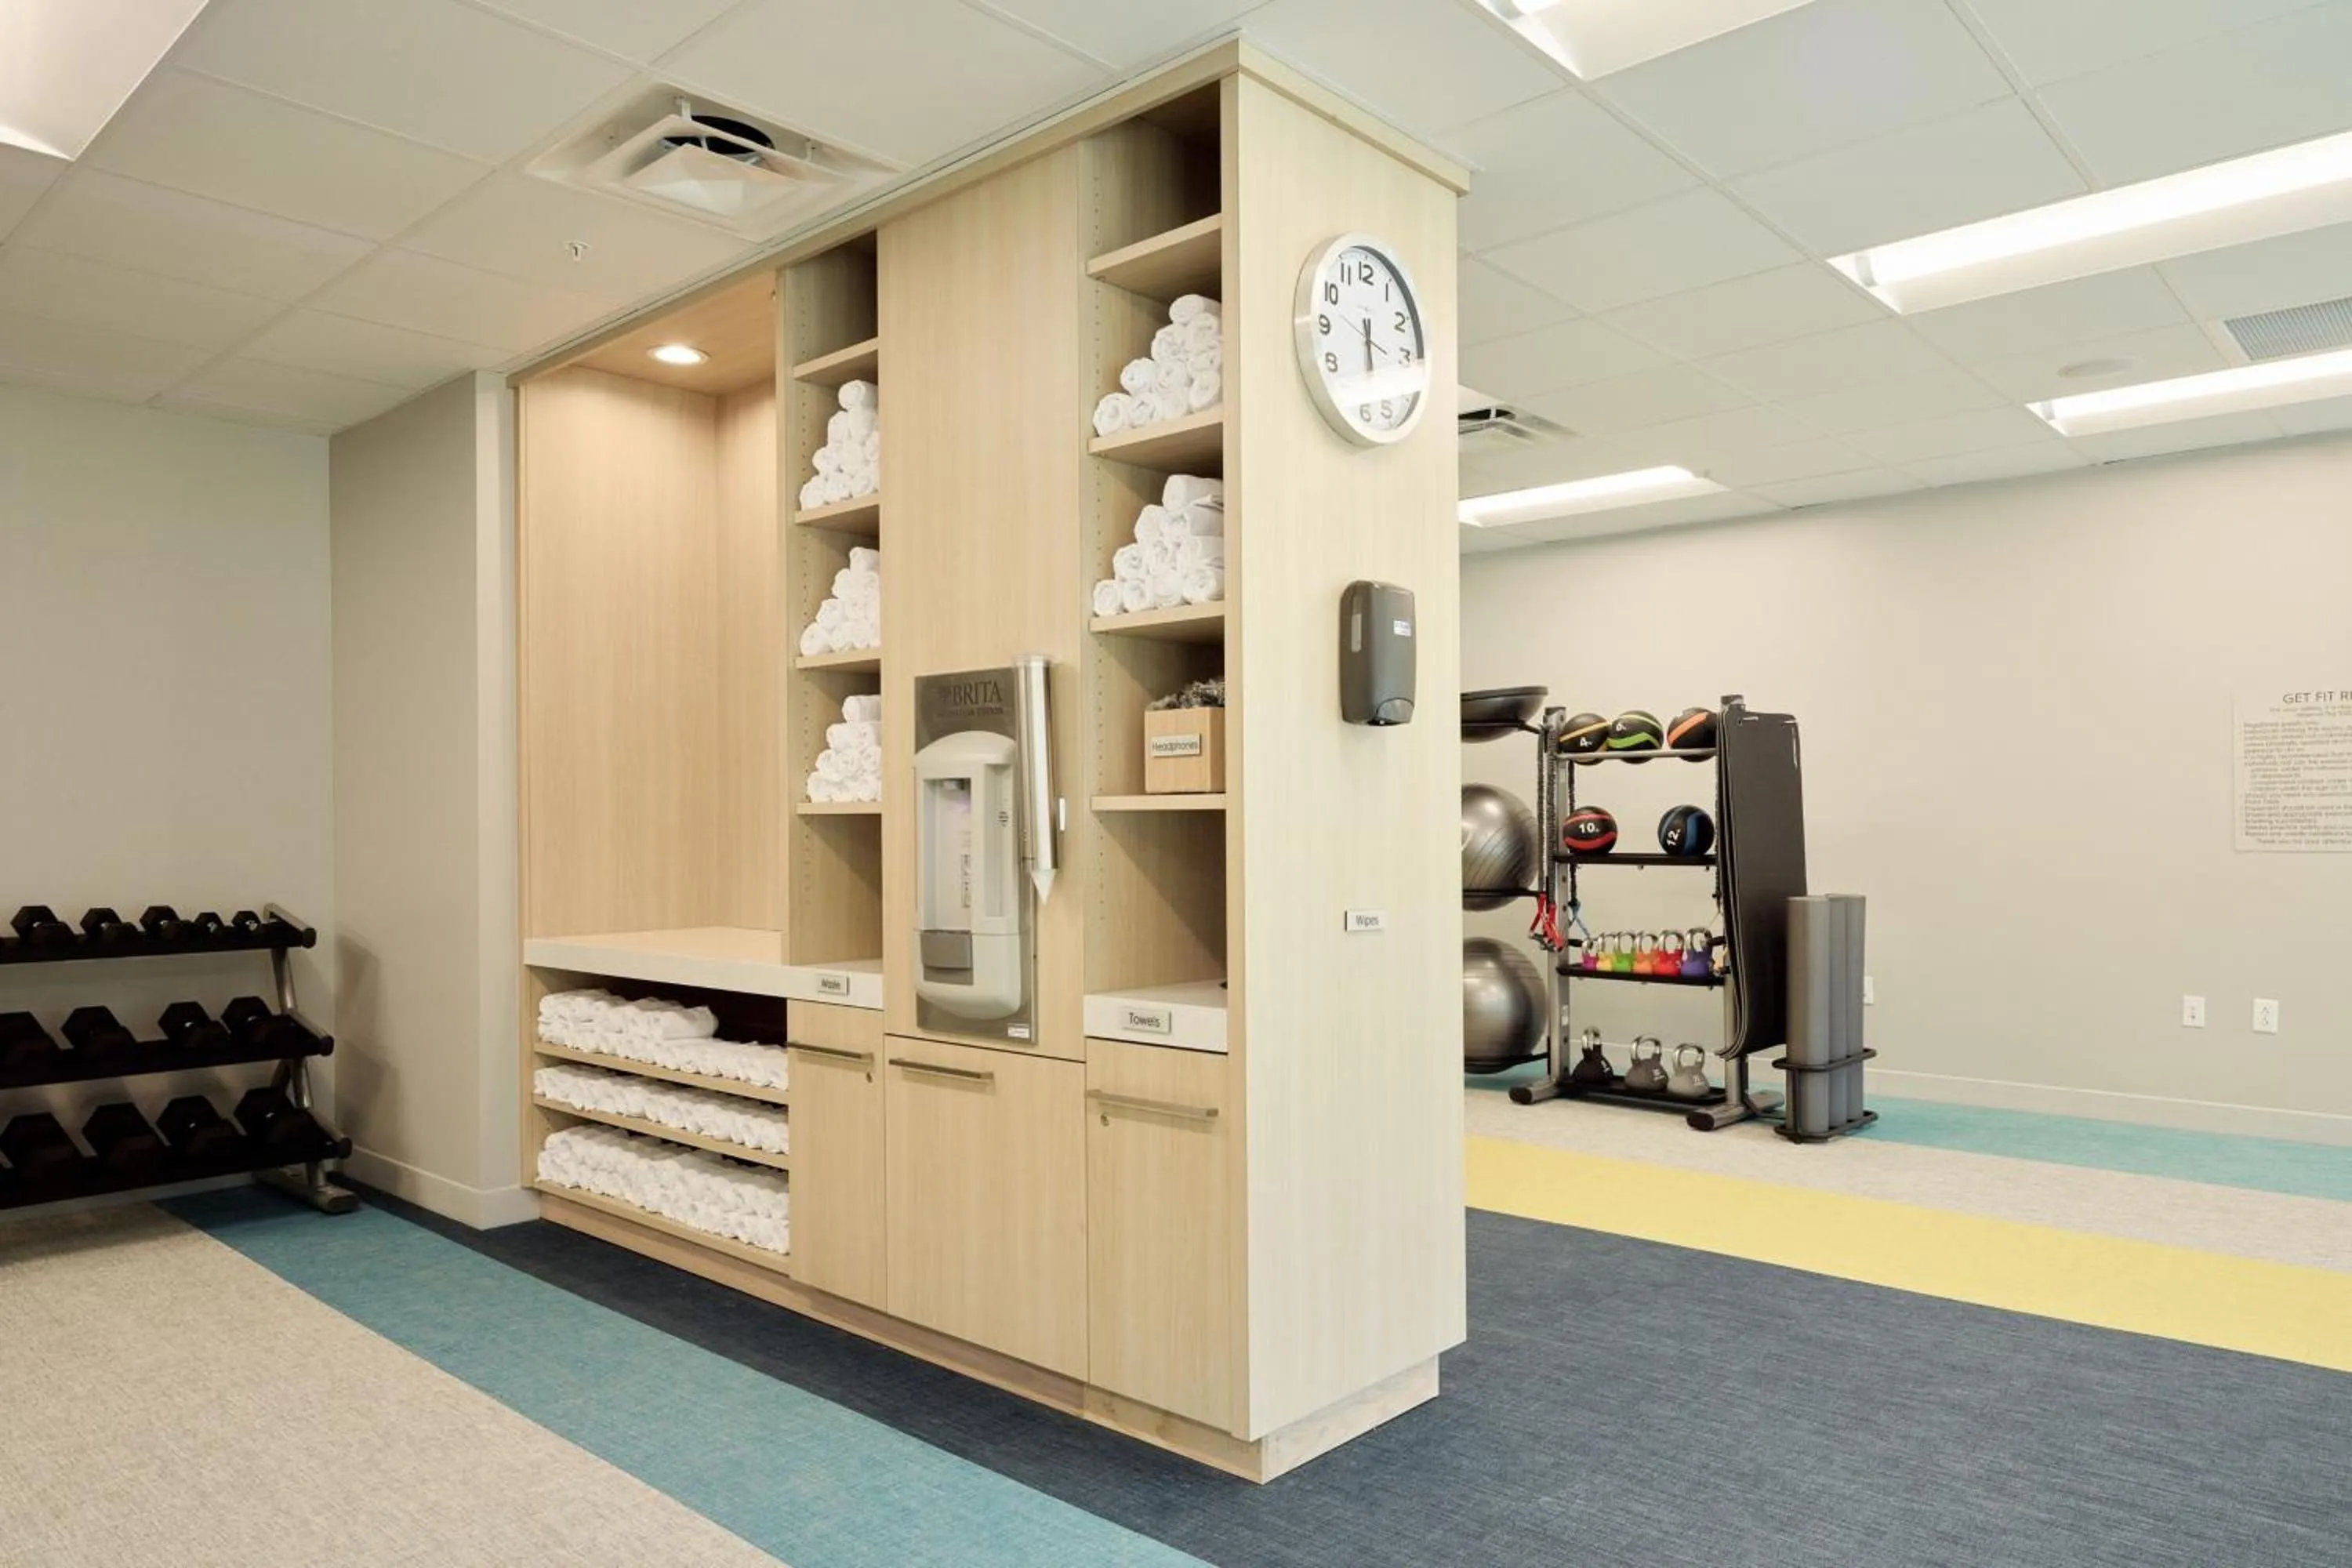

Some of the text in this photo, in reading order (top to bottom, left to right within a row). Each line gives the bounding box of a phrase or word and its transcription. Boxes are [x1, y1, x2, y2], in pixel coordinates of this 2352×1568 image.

[1340, 262, 1351, 286] 11
[1359, 260, 1374, 285] 12
[1324, 281, 1339, 306] 10
[1318, 314, 1331, 336] 9
[1394, 311, 1406, 333] 2
[1325, 352, 1339, 373] 8
[1398, 347, 1411, 366] 3
[1359, 403, 1372, 423] 6
[1380, 399, 1393, 419] 5
[953, 680, 1004, 705] BRITA
[2282, 690, 2352, 705] GET FIT R
[1578, 822, 1596, 834] 10
[1667, 830, 1679, 846] 12
[1129, 1012, 1161, 1028] Towels
